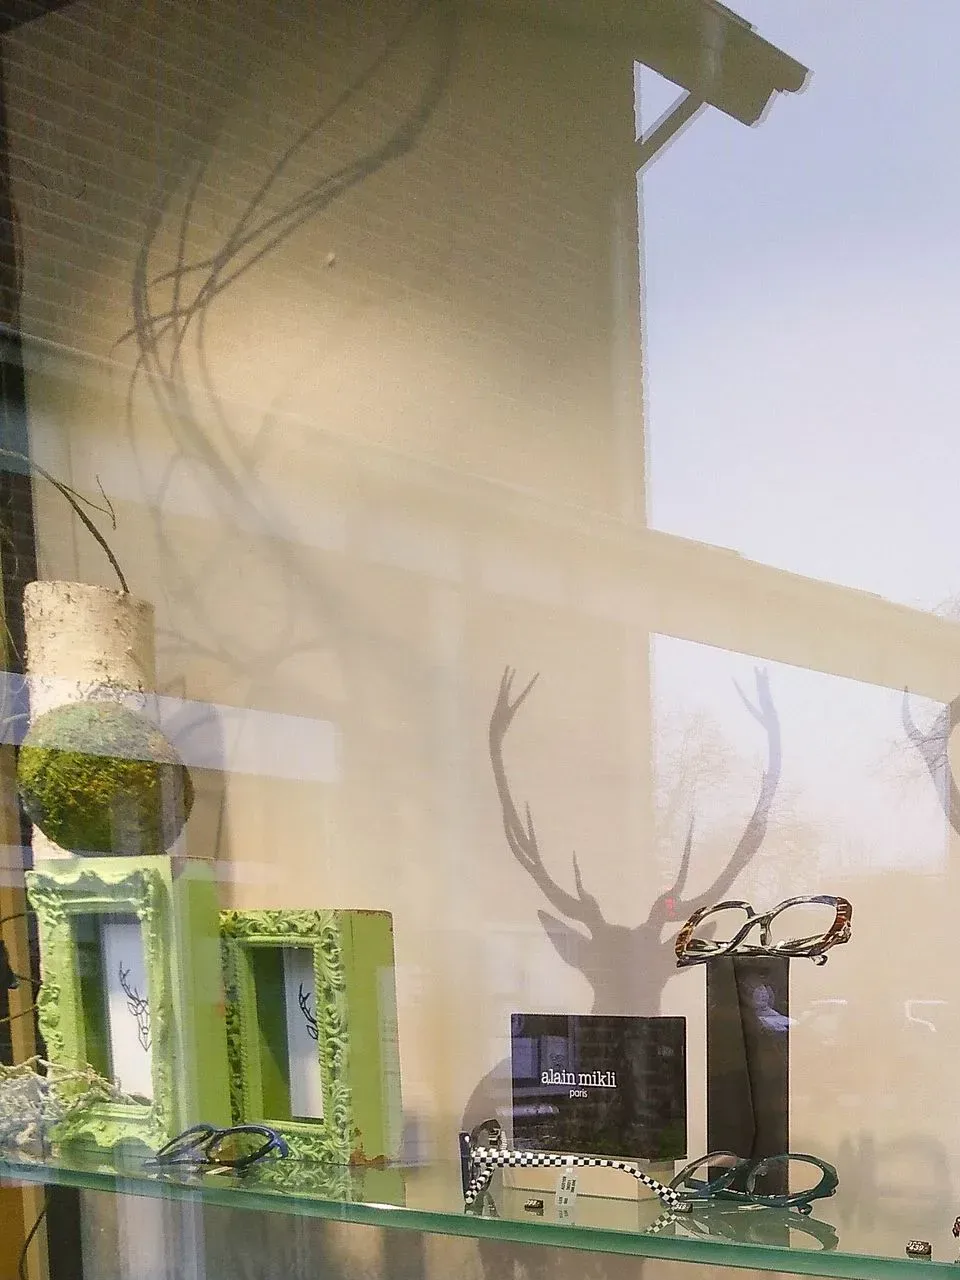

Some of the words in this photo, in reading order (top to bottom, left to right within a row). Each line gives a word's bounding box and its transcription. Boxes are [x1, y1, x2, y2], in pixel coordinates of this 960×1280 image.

[541, 1068, 576, 1085] alain
[578, 1070, 617, 1088] mikli
[569, 1088, 588, 1099] paris
